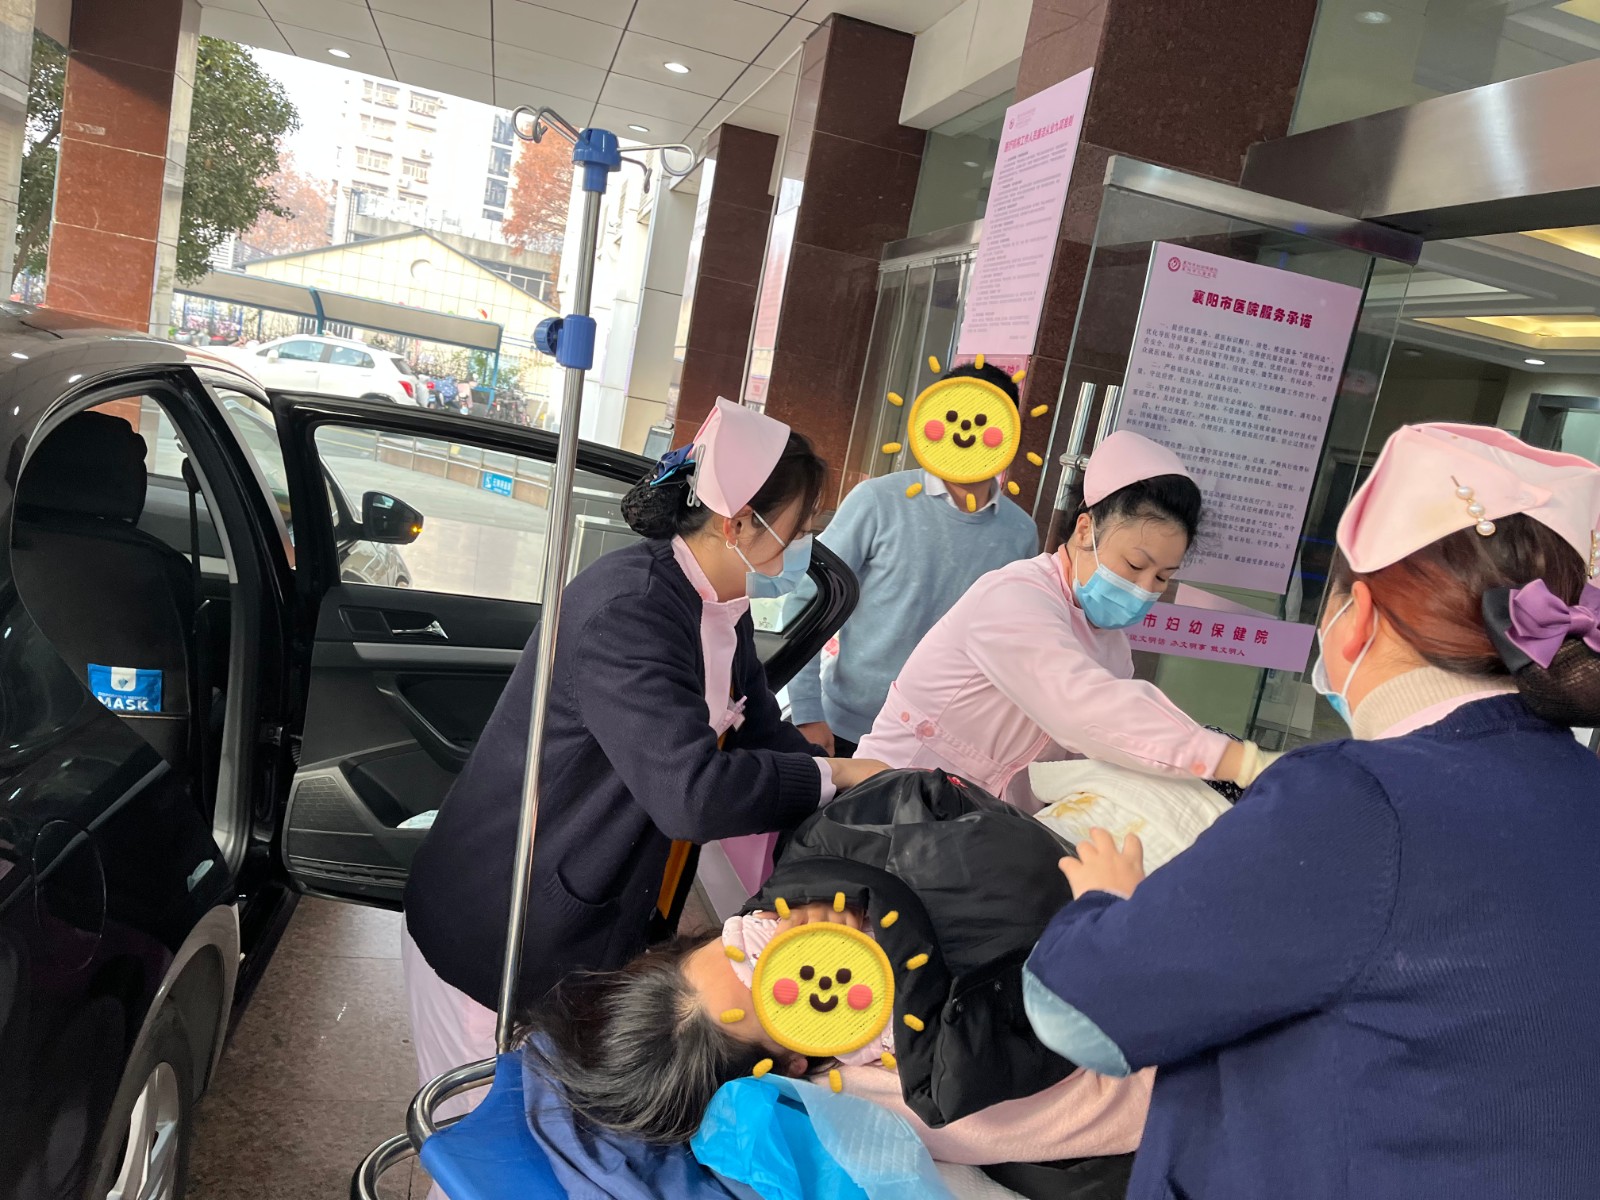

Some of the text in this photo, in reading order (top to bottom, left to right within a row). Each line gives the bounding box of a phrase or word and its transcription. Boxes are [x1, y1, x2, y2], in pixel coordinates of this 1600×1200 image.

[1192, 289, 1312, 328] 襄阳市医院服务承诺
[1143, 613, 1269, 645] 市妇幼保健院
[98, 696, 148, 711] MASK
